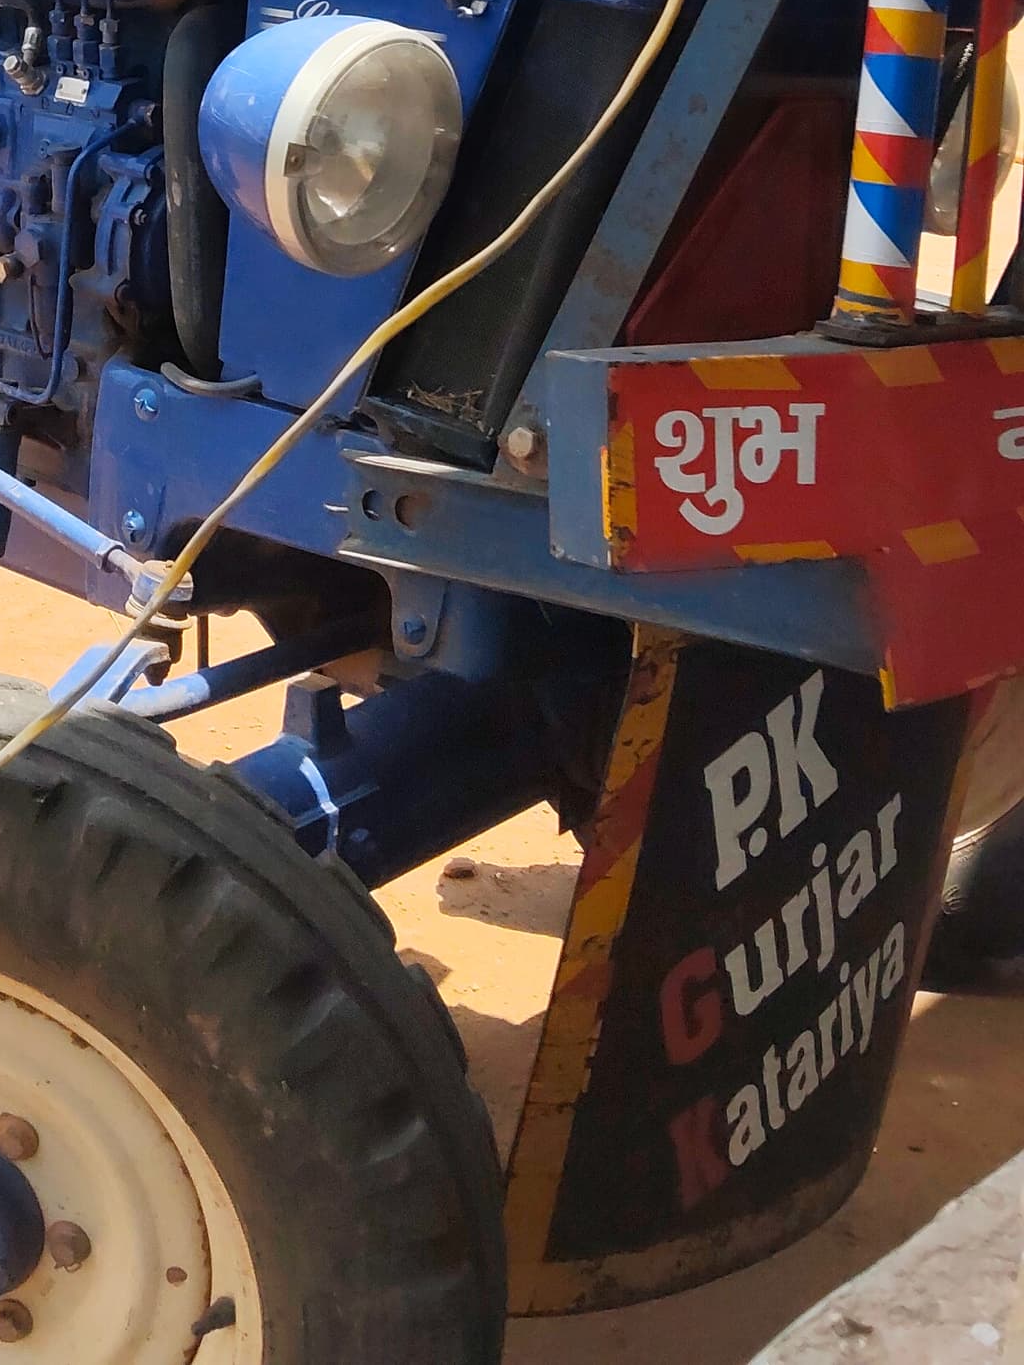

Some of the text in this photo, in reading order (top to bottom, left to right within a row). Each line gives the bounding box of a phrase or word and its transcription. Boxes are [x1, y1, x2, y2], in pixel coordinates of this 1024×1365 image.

[653, 402, 826, 536] शुभ
[703, 668, 839, 892] P.K
[660, 792, 902, 1066] Gurjar
[669, 920, 905, 1213] Katariya
